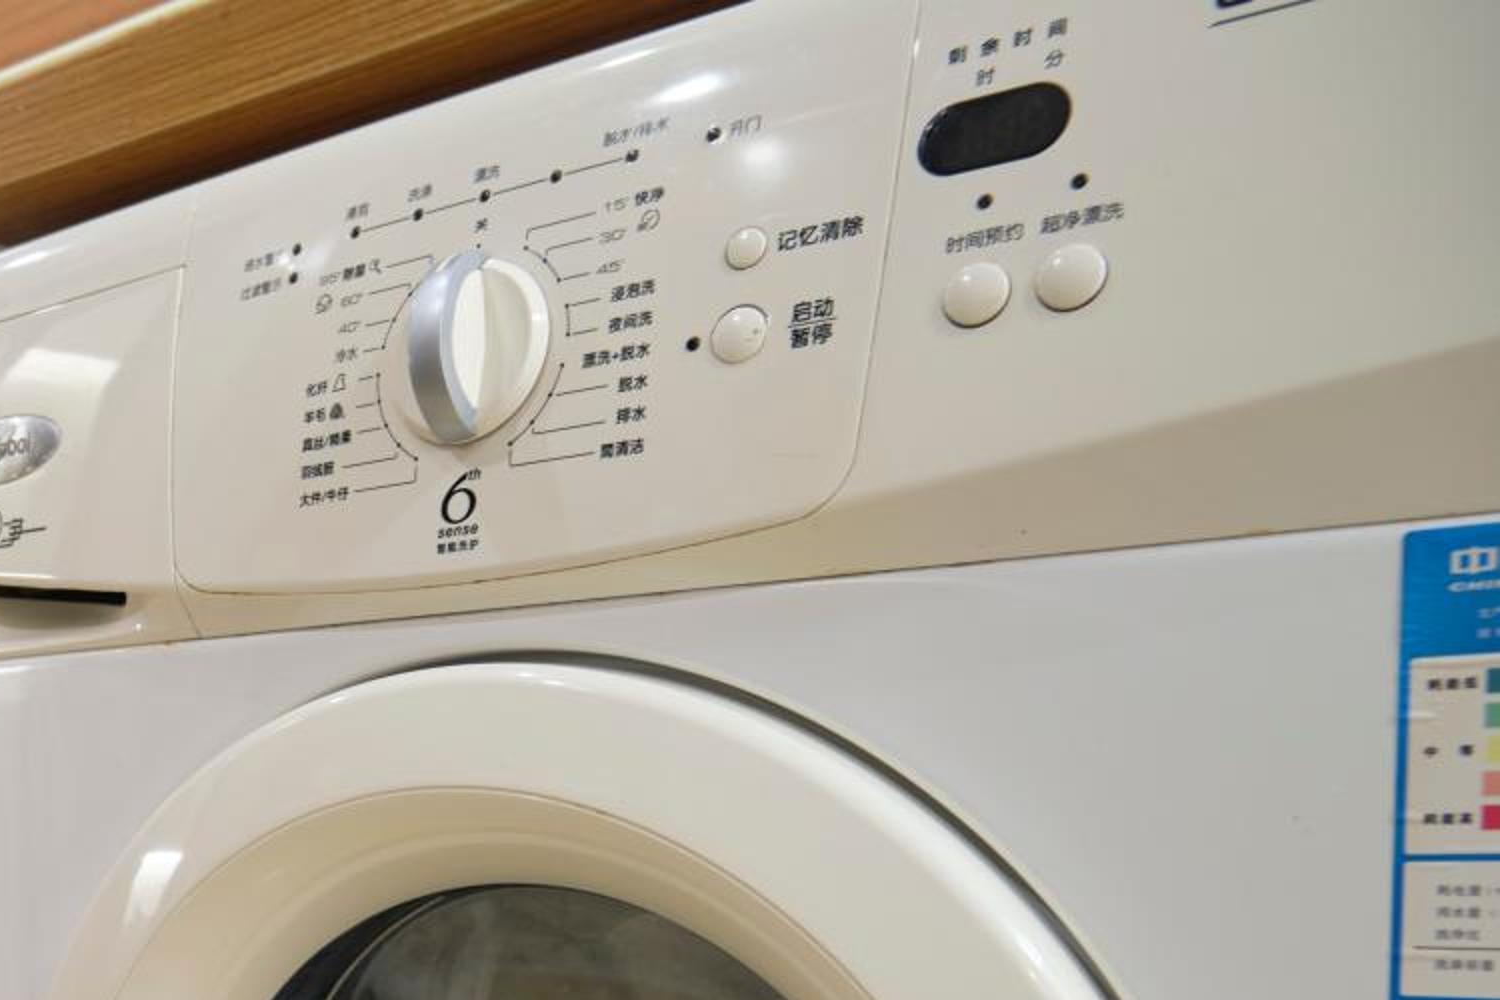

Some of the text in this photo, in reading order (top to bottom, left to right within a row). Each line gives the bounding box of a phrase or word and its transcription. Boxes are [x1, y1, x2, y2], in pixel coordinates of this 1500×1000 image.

[777, 215, 865, 252] 记忆清除
[945, 223, 1025, 254] 时间预约
[792, 297, 835, 322] 启动
[790, 323, 833, 349] 暂停
[617, 374, 649, 393] 脱水
[437, 523, 480, 539] sense
